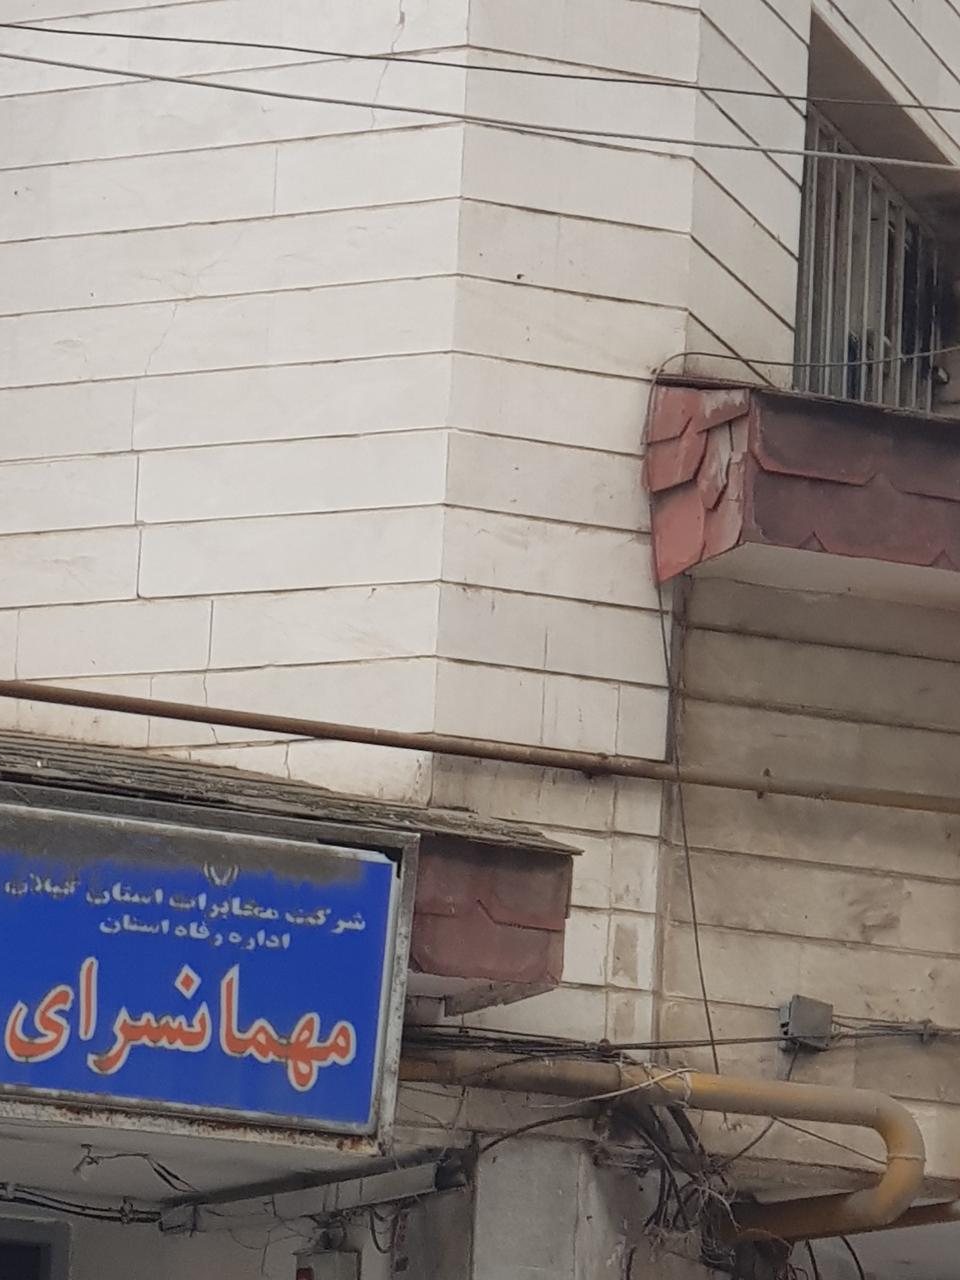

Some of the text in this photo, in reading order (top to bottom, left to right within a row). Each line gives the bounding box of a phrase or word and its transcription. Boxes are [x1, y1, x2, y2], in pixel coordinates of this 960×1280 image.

[99, 914, 290, 950] اداره رفاه استان
[4, 957, 356, 1091] مهمانسرای
